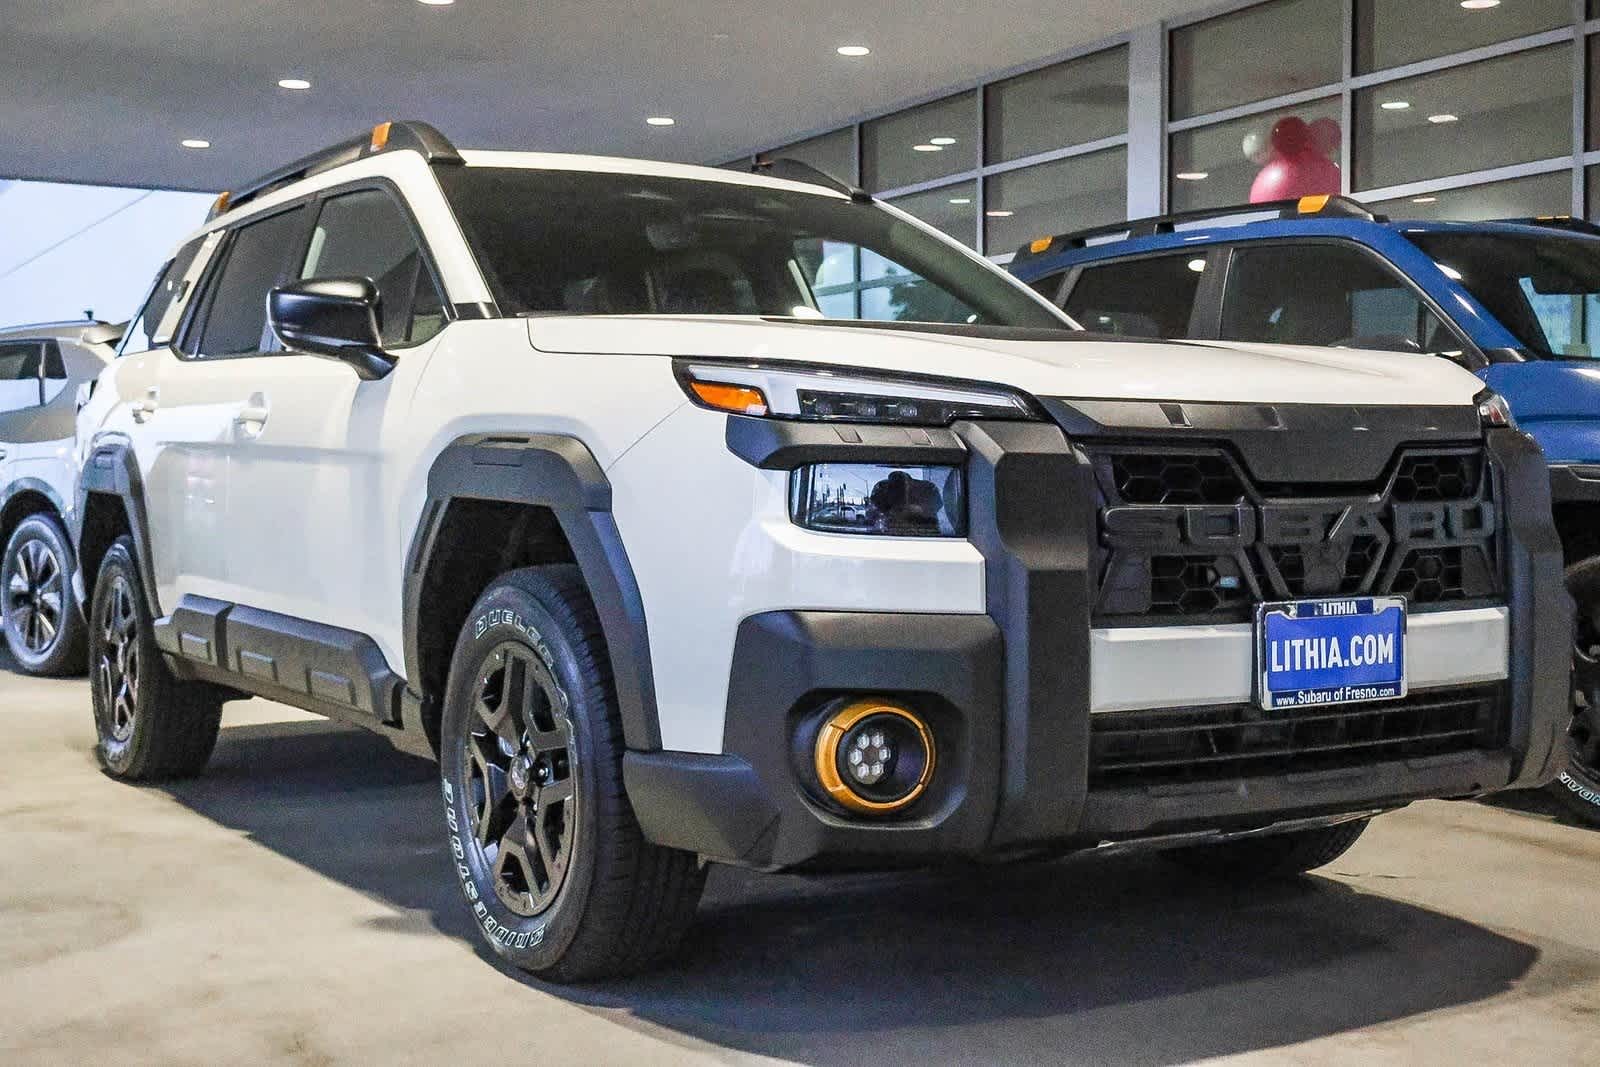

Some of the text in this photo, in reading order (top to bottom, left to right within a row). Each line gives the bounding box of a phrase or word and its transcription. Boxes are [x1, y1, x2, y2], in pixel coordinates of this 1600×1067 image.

[1103, 501, 1495, 545] SUBARU
[1323, 601, 1357, 615] LITHIA
[1271, 633, 1393, 672] LITHIA.COM
[1276, 686, 1394, 706] www.Subaru of Fresno.com
[441, 778, 546, 948] BRIDGESTONE
